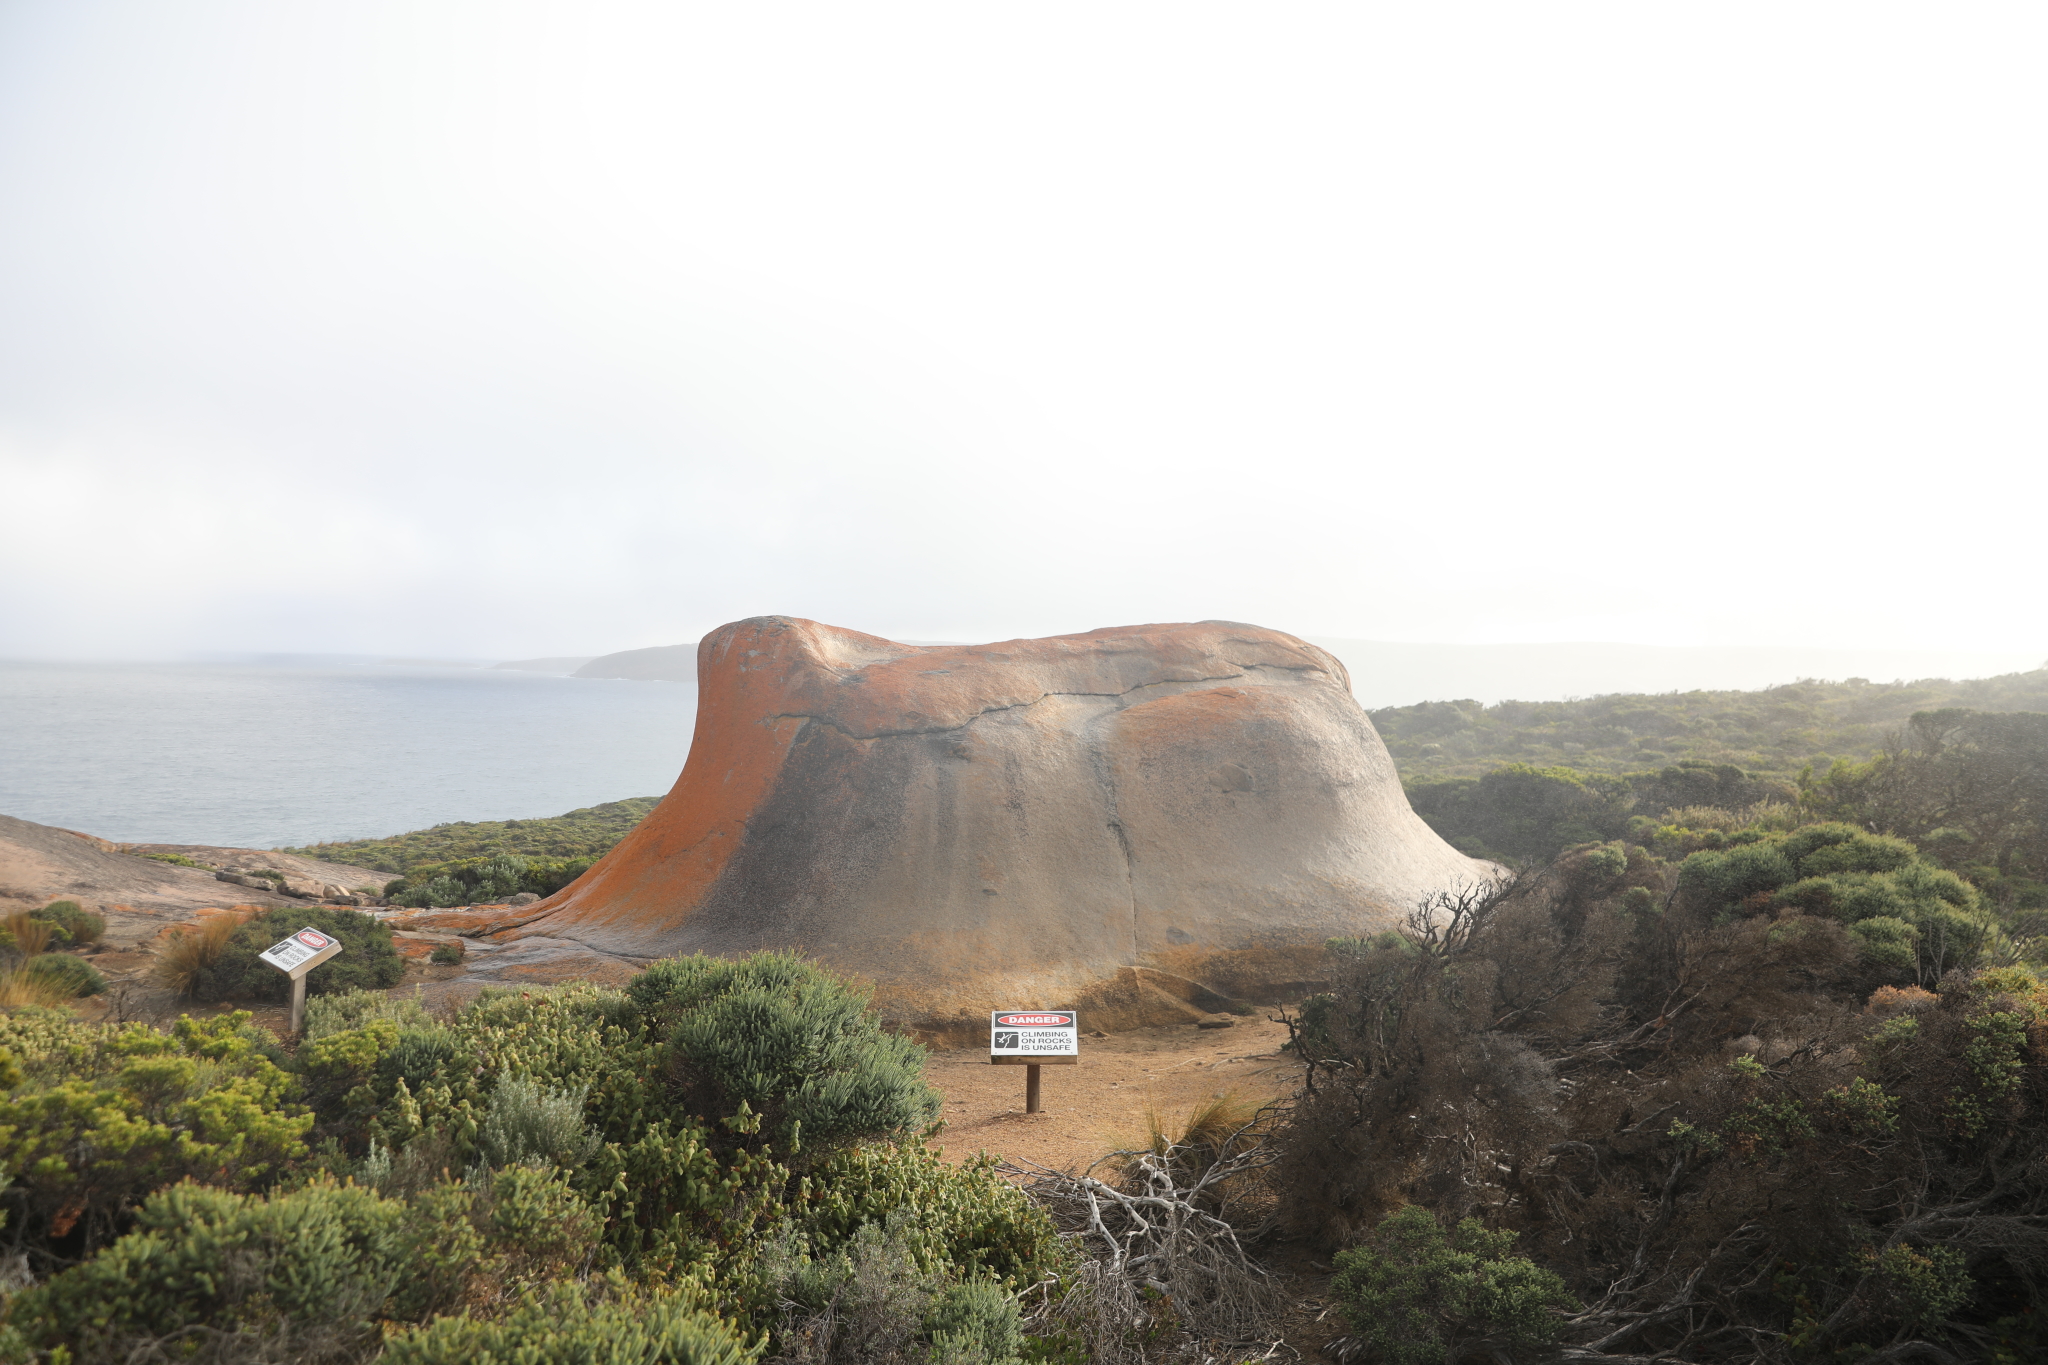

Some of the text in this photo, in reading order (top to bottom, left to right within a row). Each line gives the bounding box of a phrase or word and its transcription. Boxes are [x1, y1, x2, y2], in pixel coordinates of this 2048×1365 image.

[301, 933, 325, 947] DANGER
[290, 945, 310, 957] CLIMBING
[1008, 1016, 1060, 1024] DANGER
